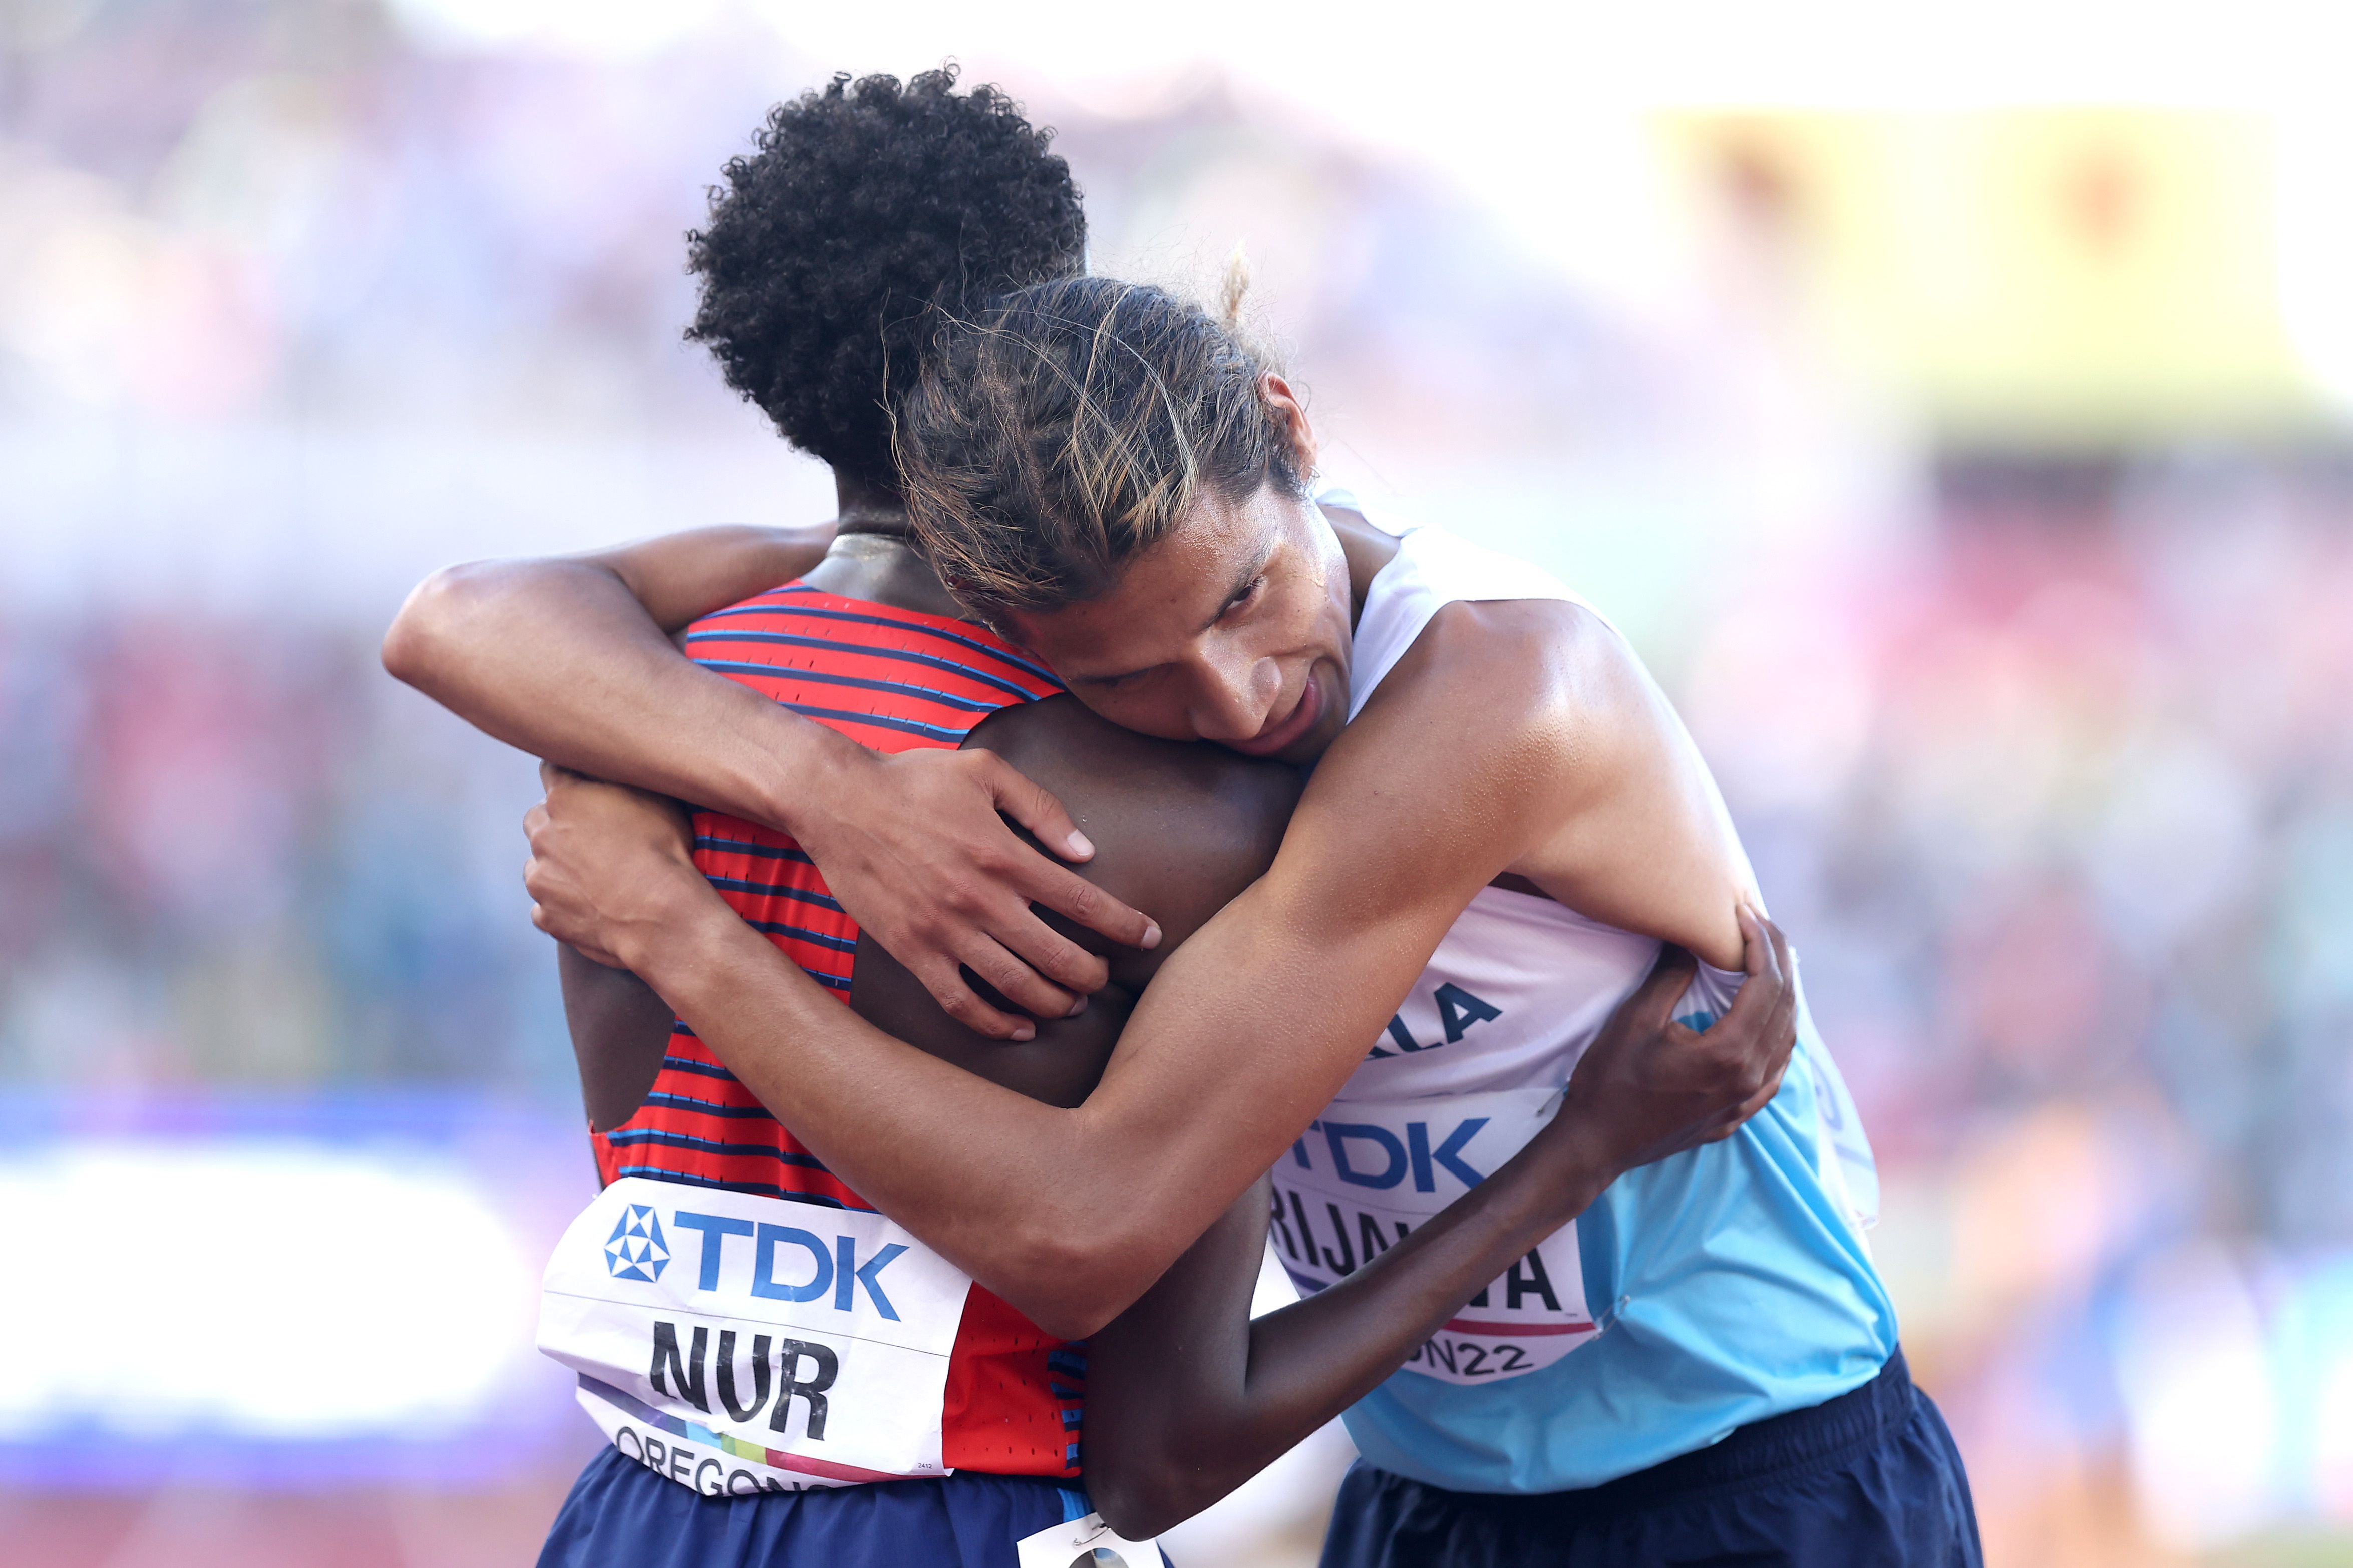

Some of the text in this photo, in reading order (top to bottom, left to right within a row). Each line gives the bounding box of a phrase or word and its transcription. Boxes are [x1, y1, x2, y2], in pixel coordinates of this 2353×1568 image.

[1364, 982, 1503, 1062] LA
[674, 1210, 910, 1322] TDK
[1270, 1185, 1562, 1311] RIJAA
[650, 1321, 839, 1442] NUR
[1409, 1338, 1533, 1376] N22
